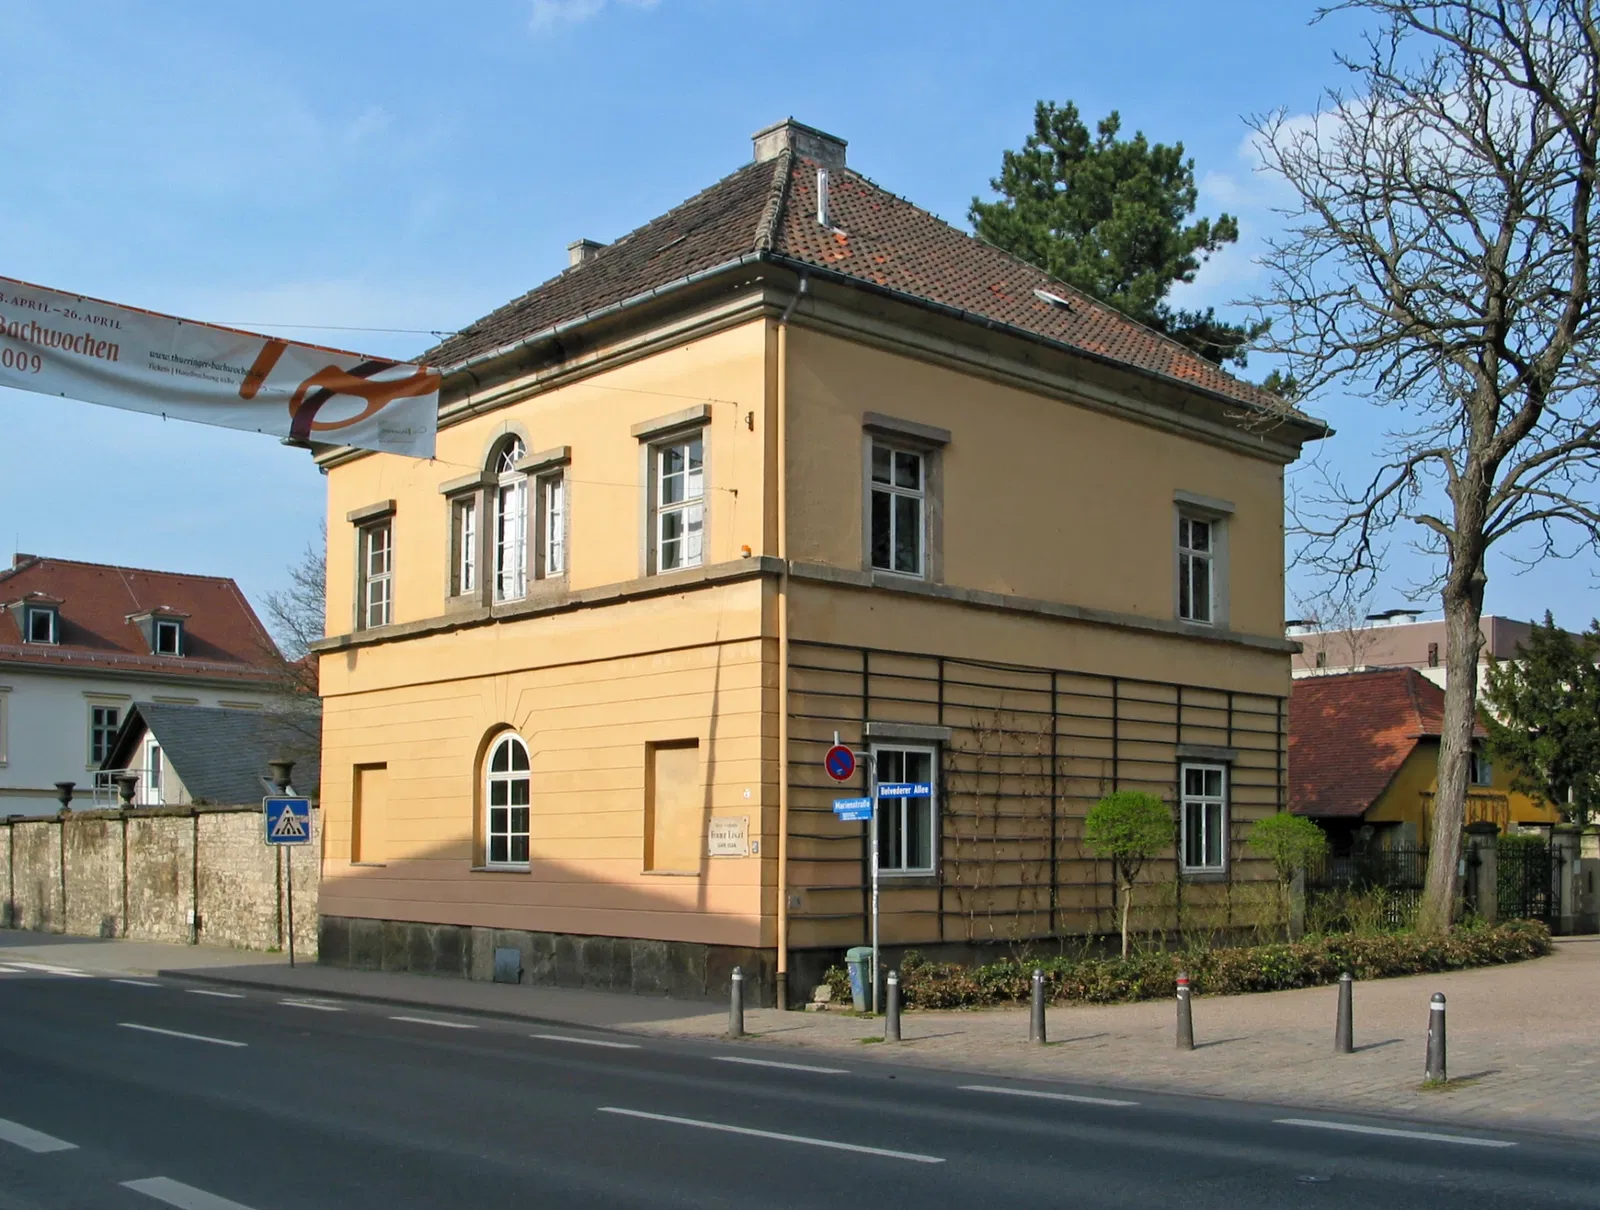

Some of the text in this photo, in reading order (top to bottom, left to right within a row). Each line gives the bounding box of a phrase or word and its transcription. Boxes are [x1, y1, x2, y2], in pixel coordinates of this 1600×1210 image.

[11, 296, 51, 313] APRIL
[84, 314, 121, 330] APRIL
[880, 784, 929, 796] Belvederer Allee
[835, 799, 870, 810] Marienstraße
